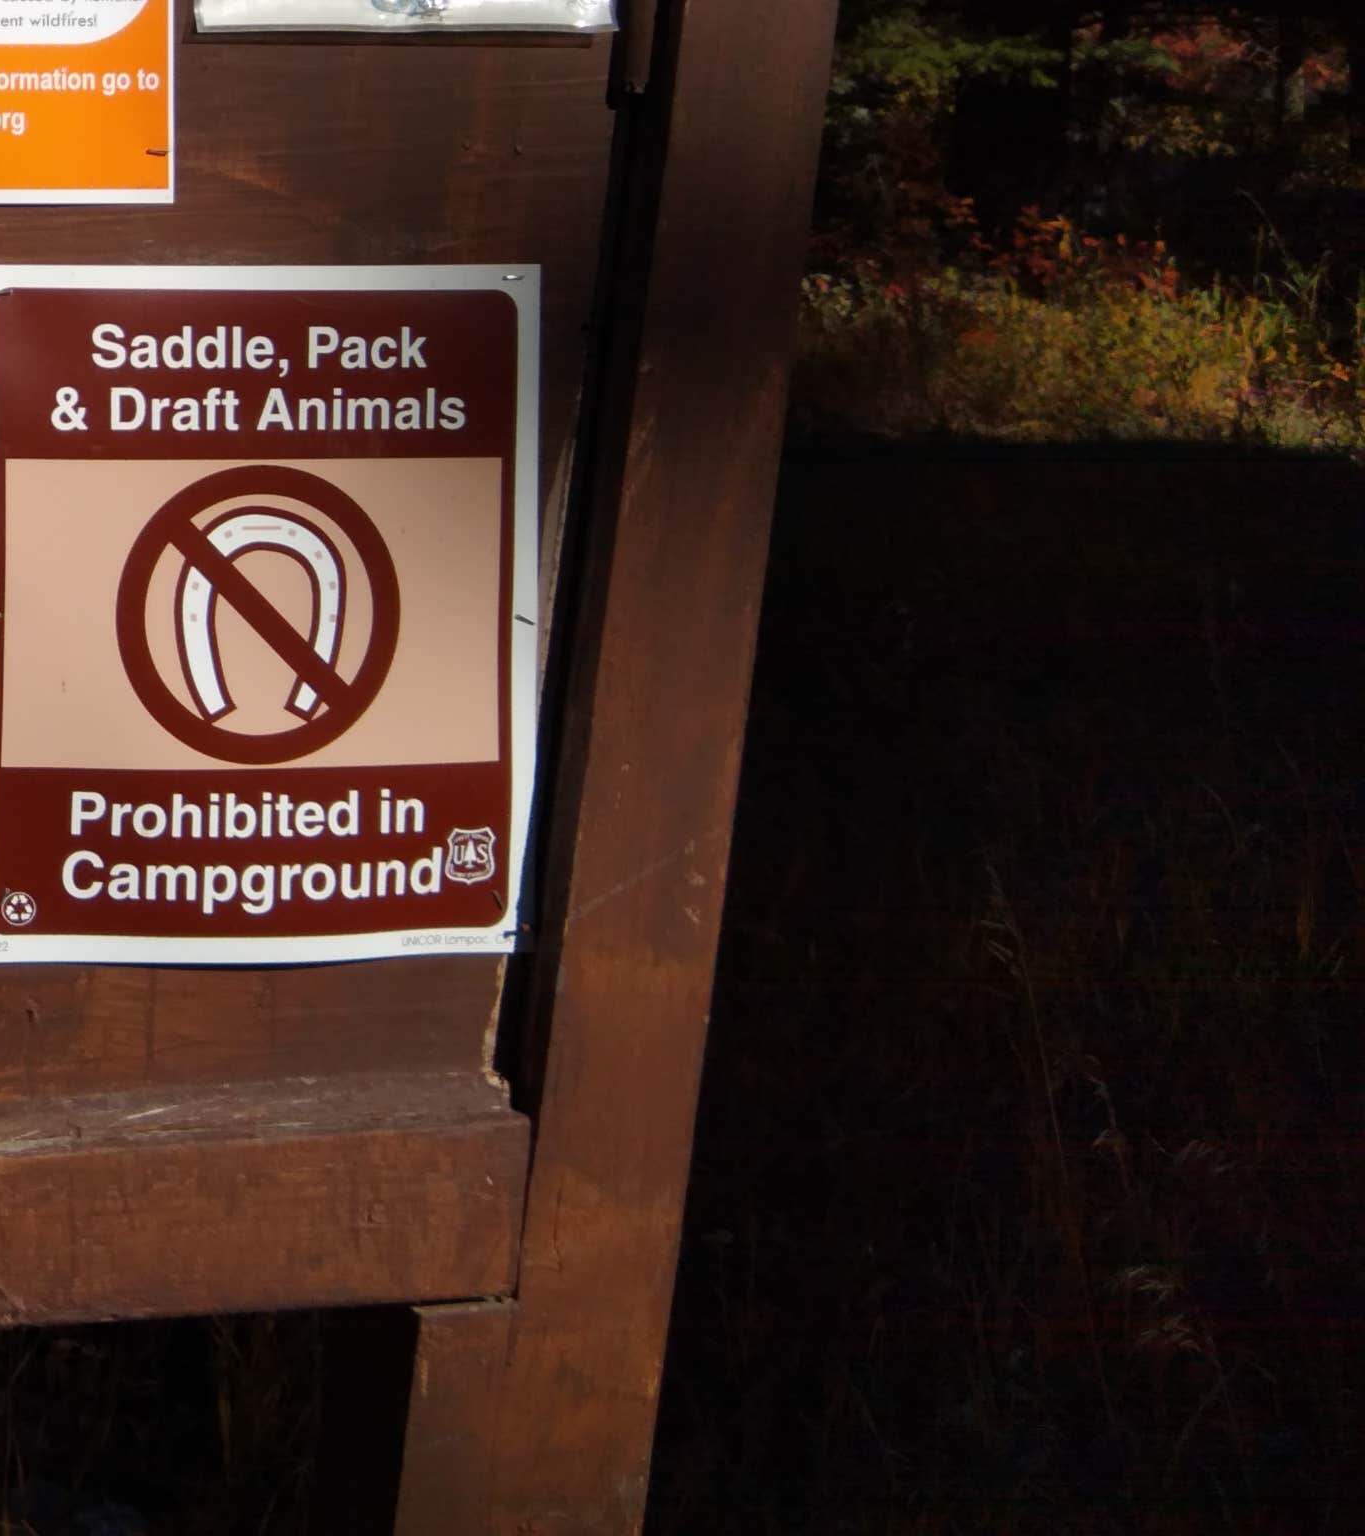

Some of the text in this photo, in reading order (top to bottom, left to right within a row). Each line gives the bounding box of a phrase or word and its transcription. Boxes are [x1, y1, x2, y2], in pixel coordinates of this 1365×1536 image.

[102, 72, 132, 96] go
[137, 69, 160, 91] to
[92, 323, 426, 377] Saddle, Pack
[51, 387, 464, 431] & Draft Animals
[71, 789, 424, 838] Prohibited in
[62, 847, 443, 914] Campground
